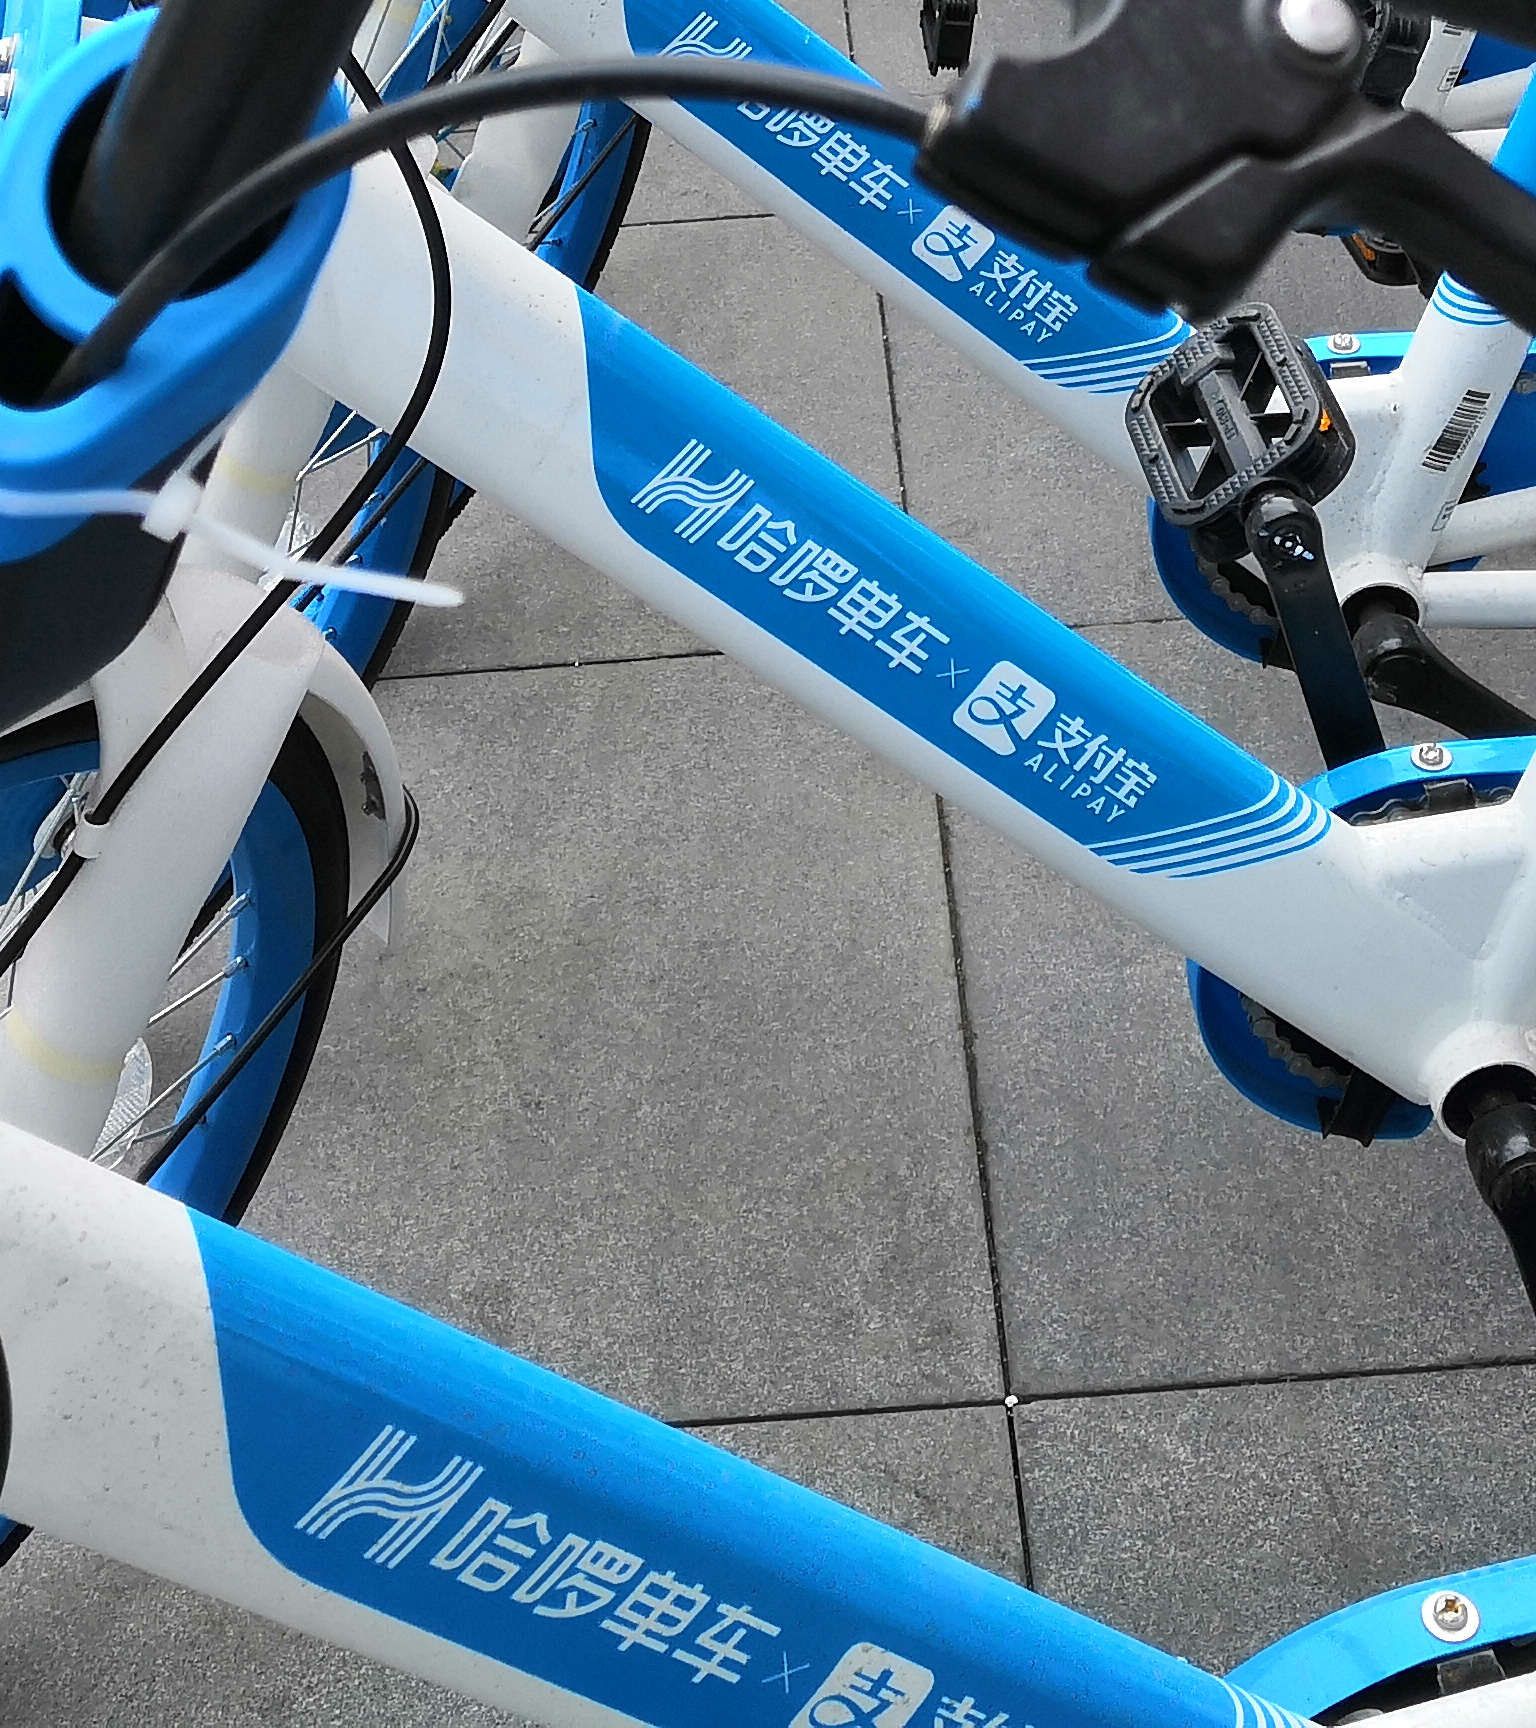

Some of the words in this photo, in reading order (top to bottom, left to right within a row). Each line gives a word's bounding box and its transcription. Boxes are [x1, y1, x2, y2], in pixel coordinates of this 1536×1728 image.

[968, 280, 1054, 345] ALIPAY
[978, 248, 1080, 333] 支付宝
[715, 503, 951, 676] 哈啰单车
[1037, 712, 1159, 810] 支付宝
[1023, 752, 1129, 825] ALIPAY
[430, 1495, 783, 1687] 哈啰单车
